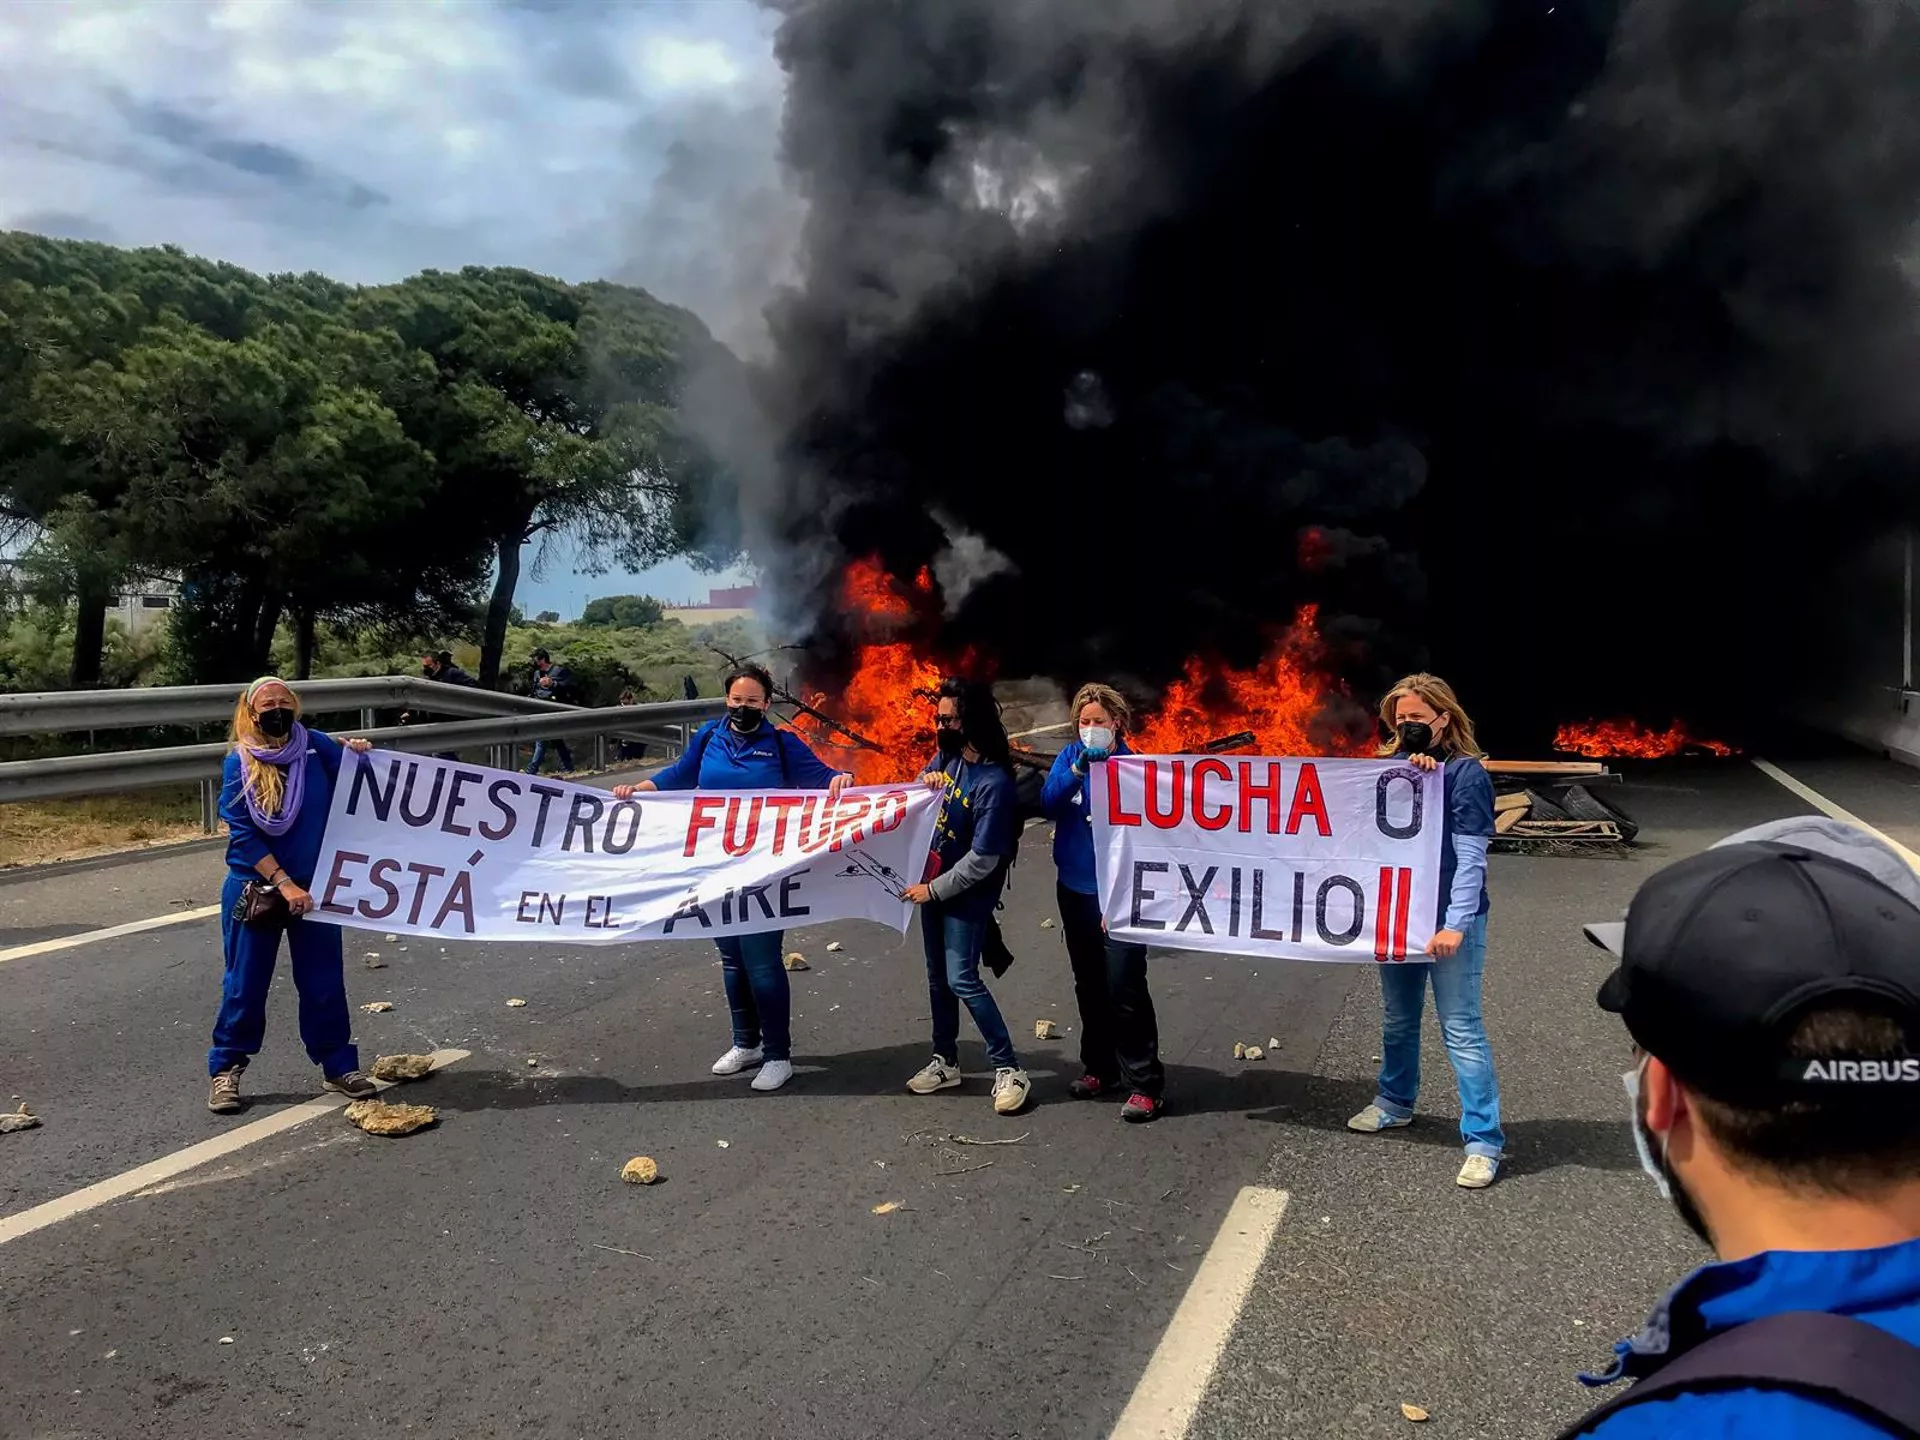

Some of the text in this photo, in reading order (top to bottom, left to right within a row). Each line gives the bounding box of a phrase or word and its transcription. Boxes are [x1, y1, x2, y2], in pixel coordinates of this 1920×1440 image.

[346, 753, 643, 855] NUESTRO
[683, 790, 908, 858] FUTURO
[1106, 758, 1423, 840] LUCHA O
[320, 849, 811, 934] ESTÁ EN EL AIRE
[1803, 1059, 1920, 1082] AIRBUS
